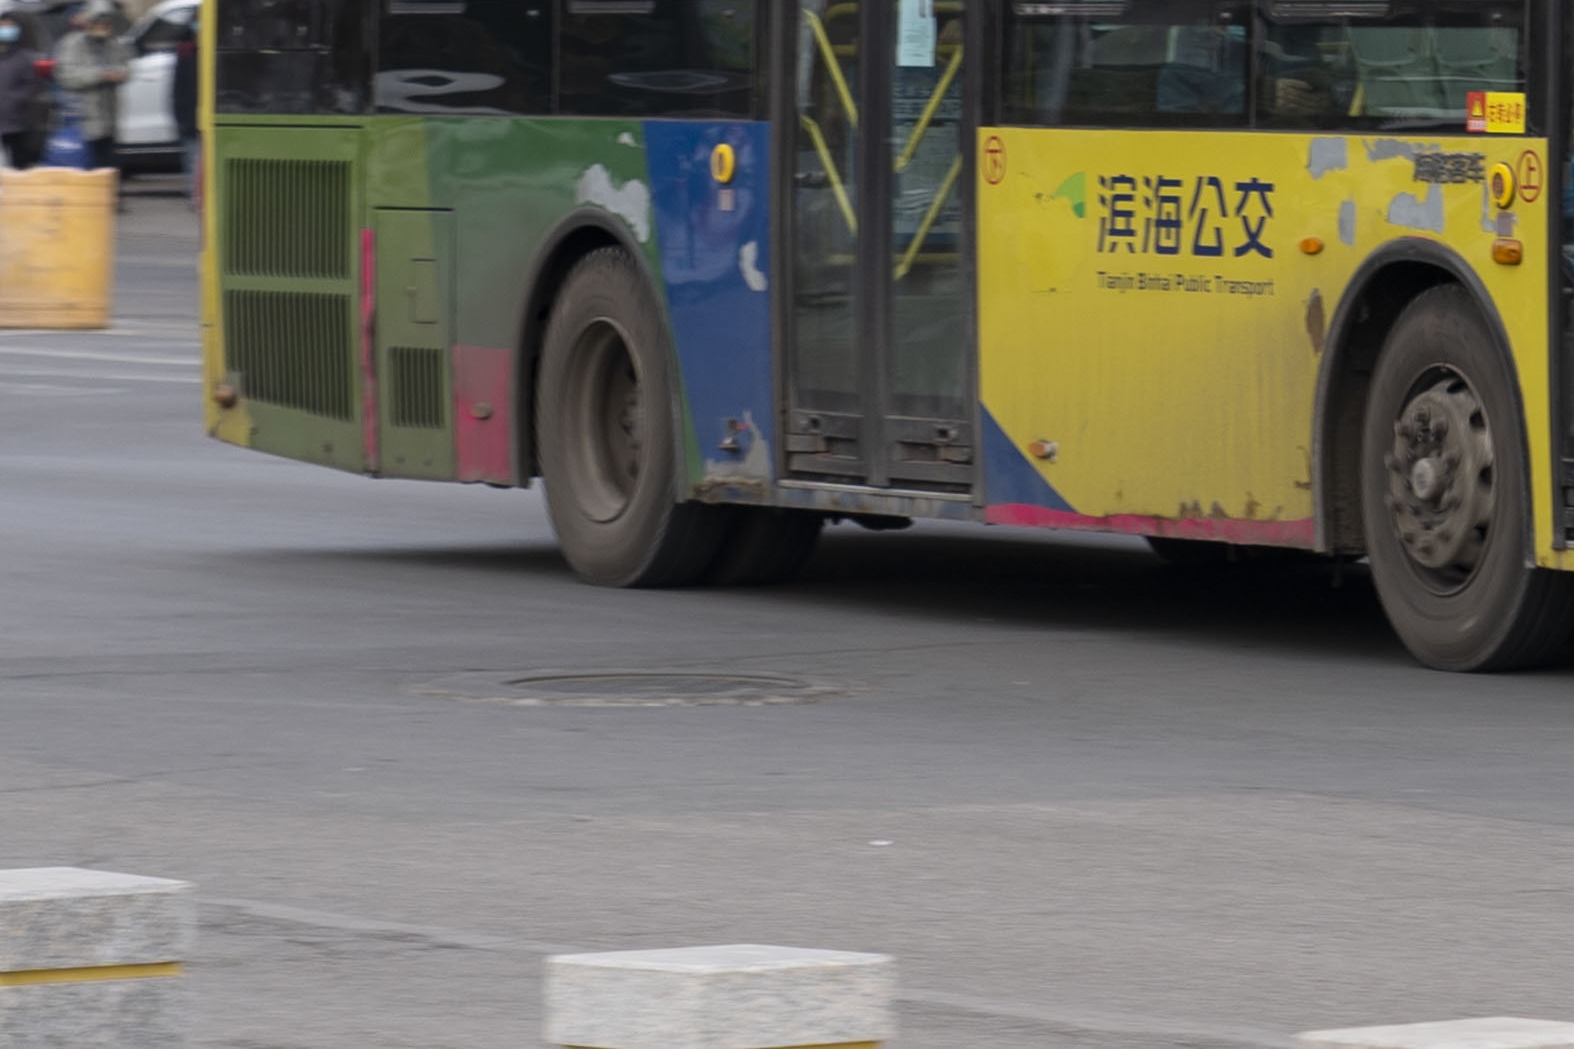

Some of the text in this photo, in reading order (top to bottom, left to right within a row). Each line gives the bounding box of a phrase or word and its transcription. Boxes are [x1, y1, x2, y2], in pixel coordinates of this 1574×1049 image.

[1097, 174, 1275, 259] 滨海公交
[1176, 273, 1212, 292] Public
[1214, 275, 1275, 297] Transport
